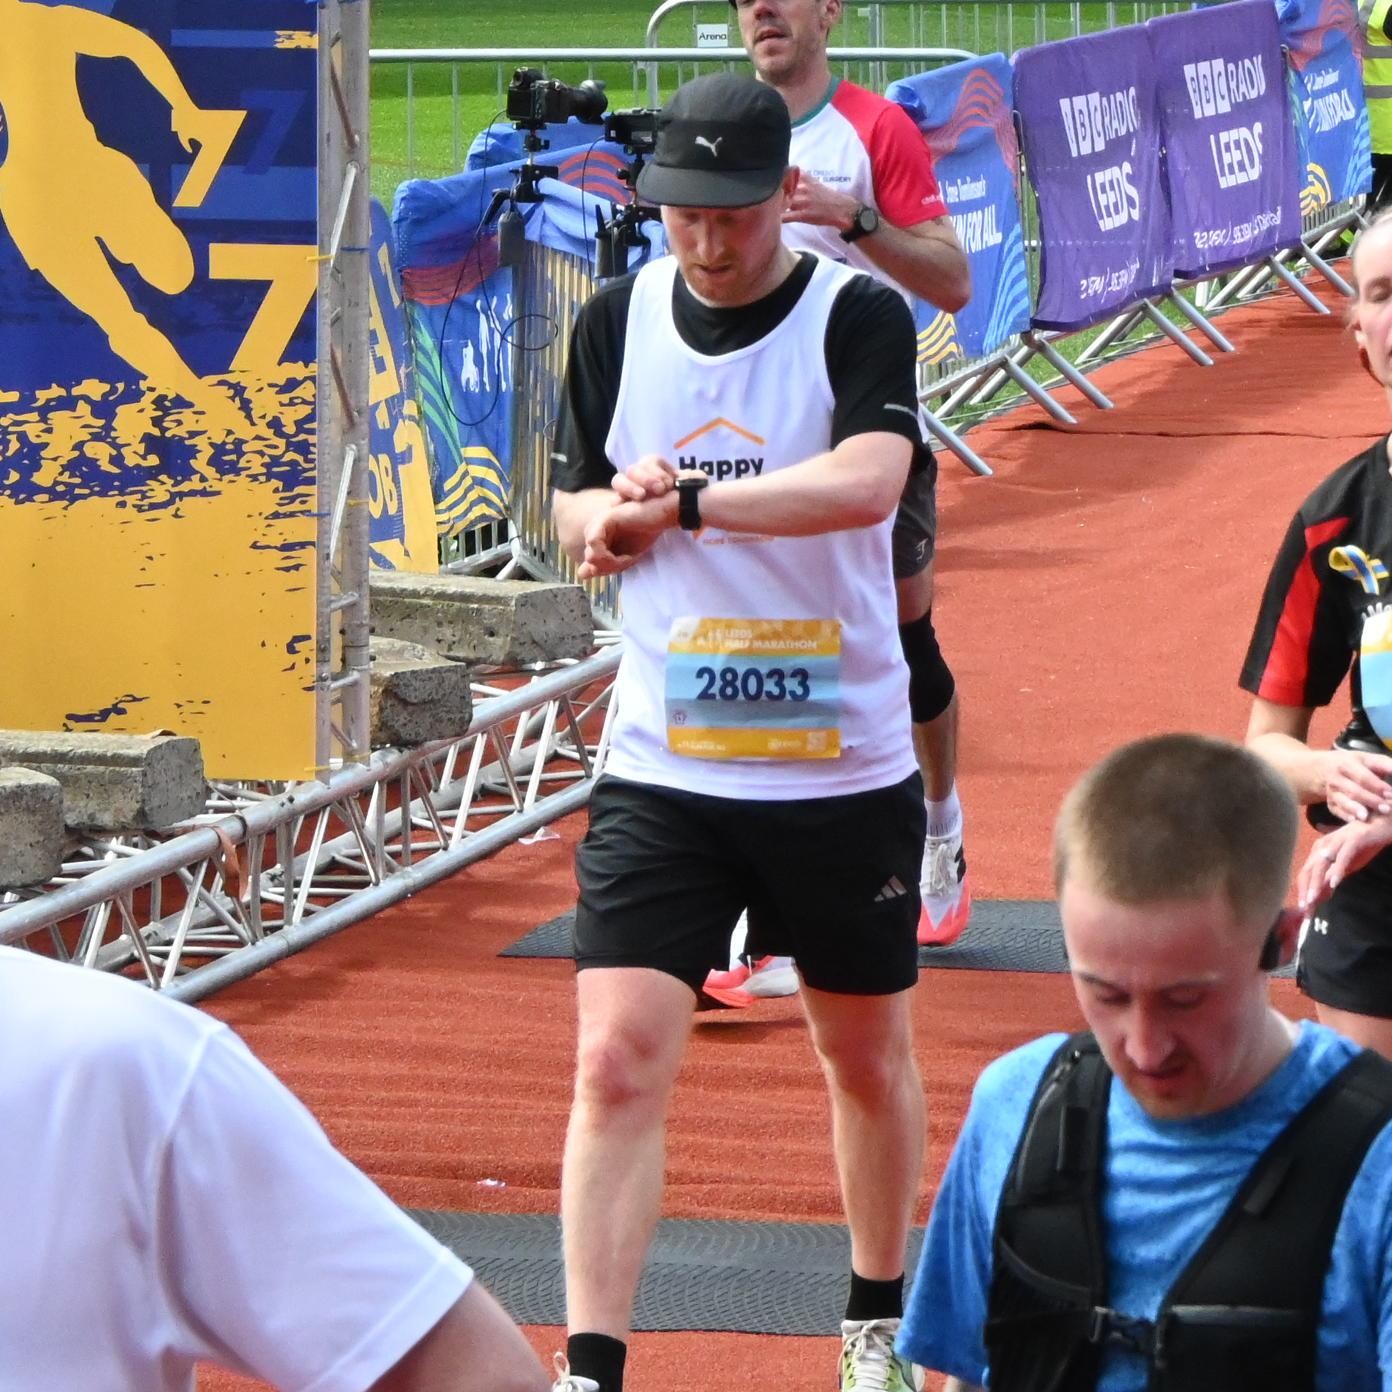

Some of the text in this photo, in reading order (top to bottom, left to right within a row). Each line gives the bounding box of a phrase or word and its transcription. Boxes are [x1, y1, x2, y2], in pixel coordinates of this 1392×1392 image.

[698, 32, 728, 40] Arena
[1183, 58, 1232, 120] BBC
[1209, 121, 1263, 190] LEEDS
[1086, 161, 1140, 233] LEEDS
[678, 456, 764, 481] Happy
[752, 640, 817, 649] MARATHON
[695, 666, 811, 702] 28033
